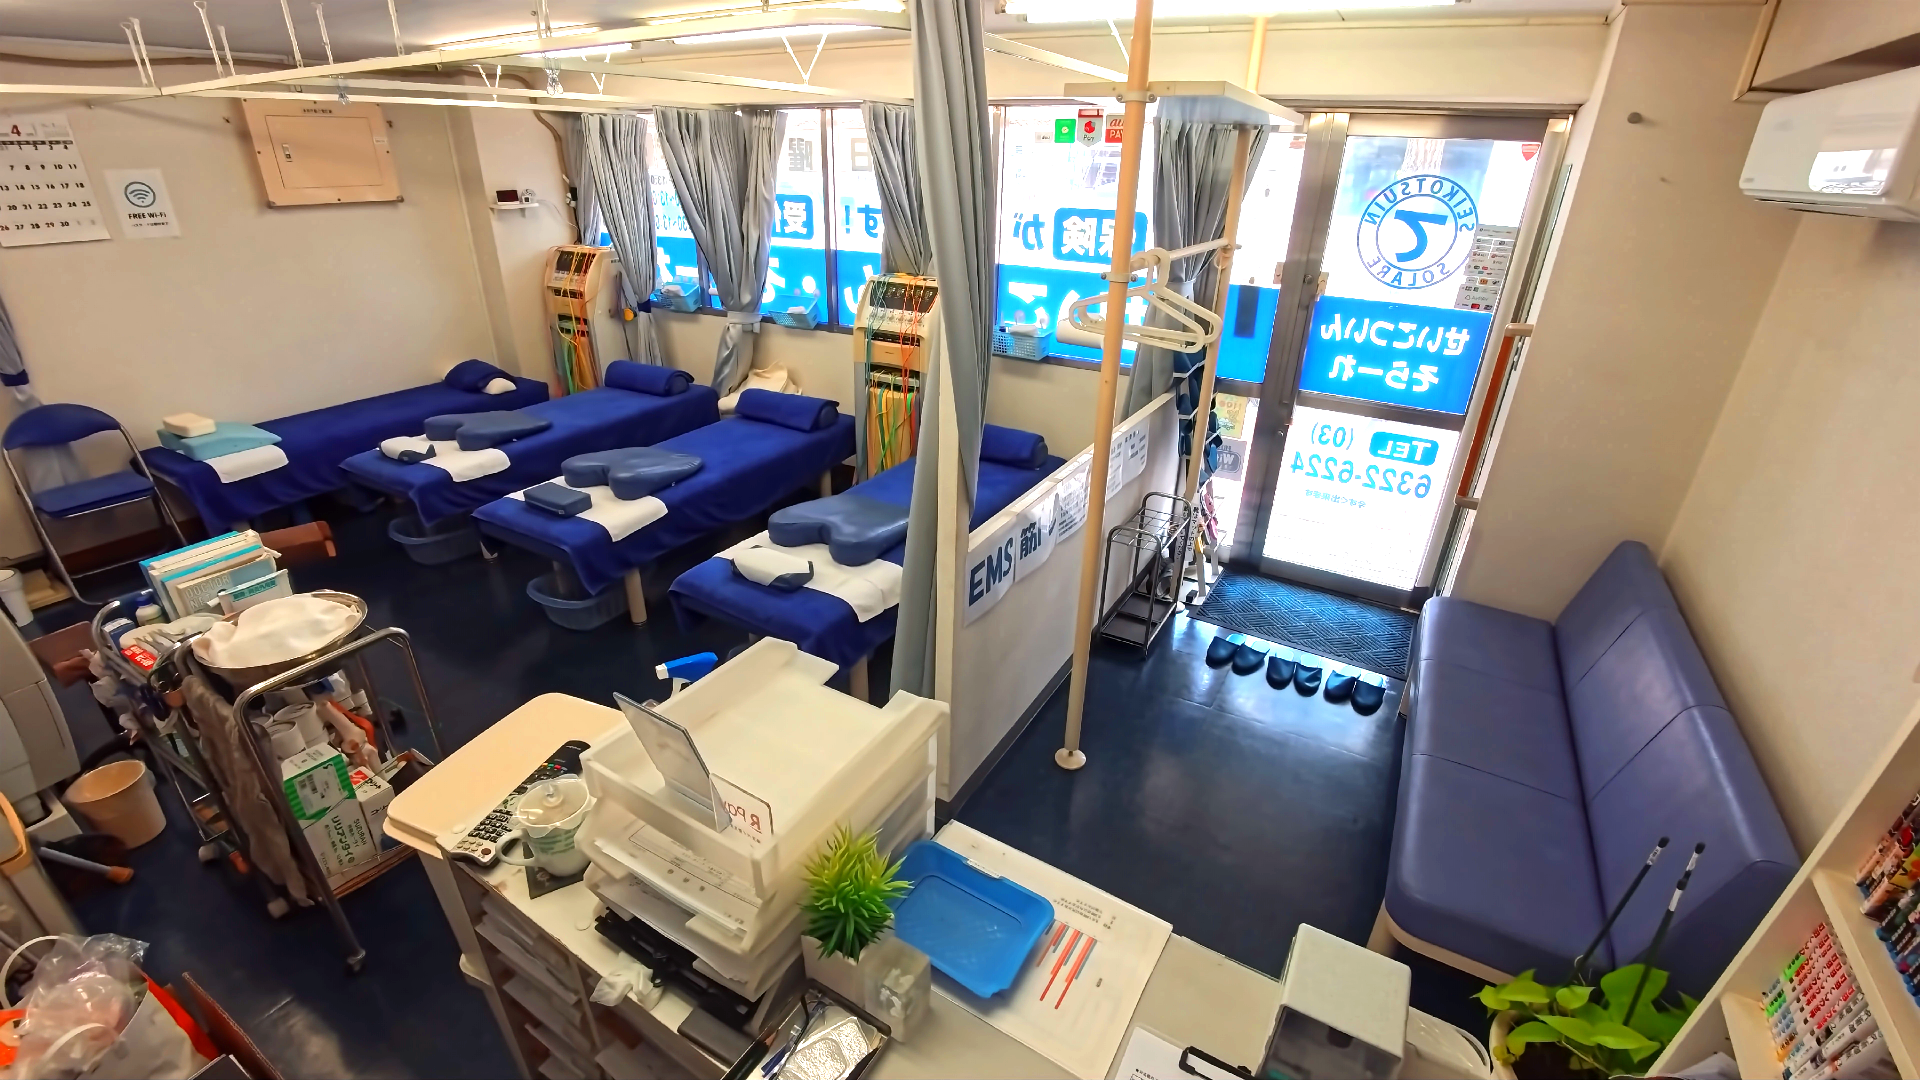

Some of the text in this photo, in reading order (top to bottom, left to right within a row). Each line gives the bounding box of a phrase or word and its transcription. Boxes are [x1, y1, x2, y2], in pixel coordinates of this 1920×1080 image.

[11, 124, 21, 137] 4
[969, 537, 1014, 607] EMS
[185, 574, 231, 599] DOCTOR
